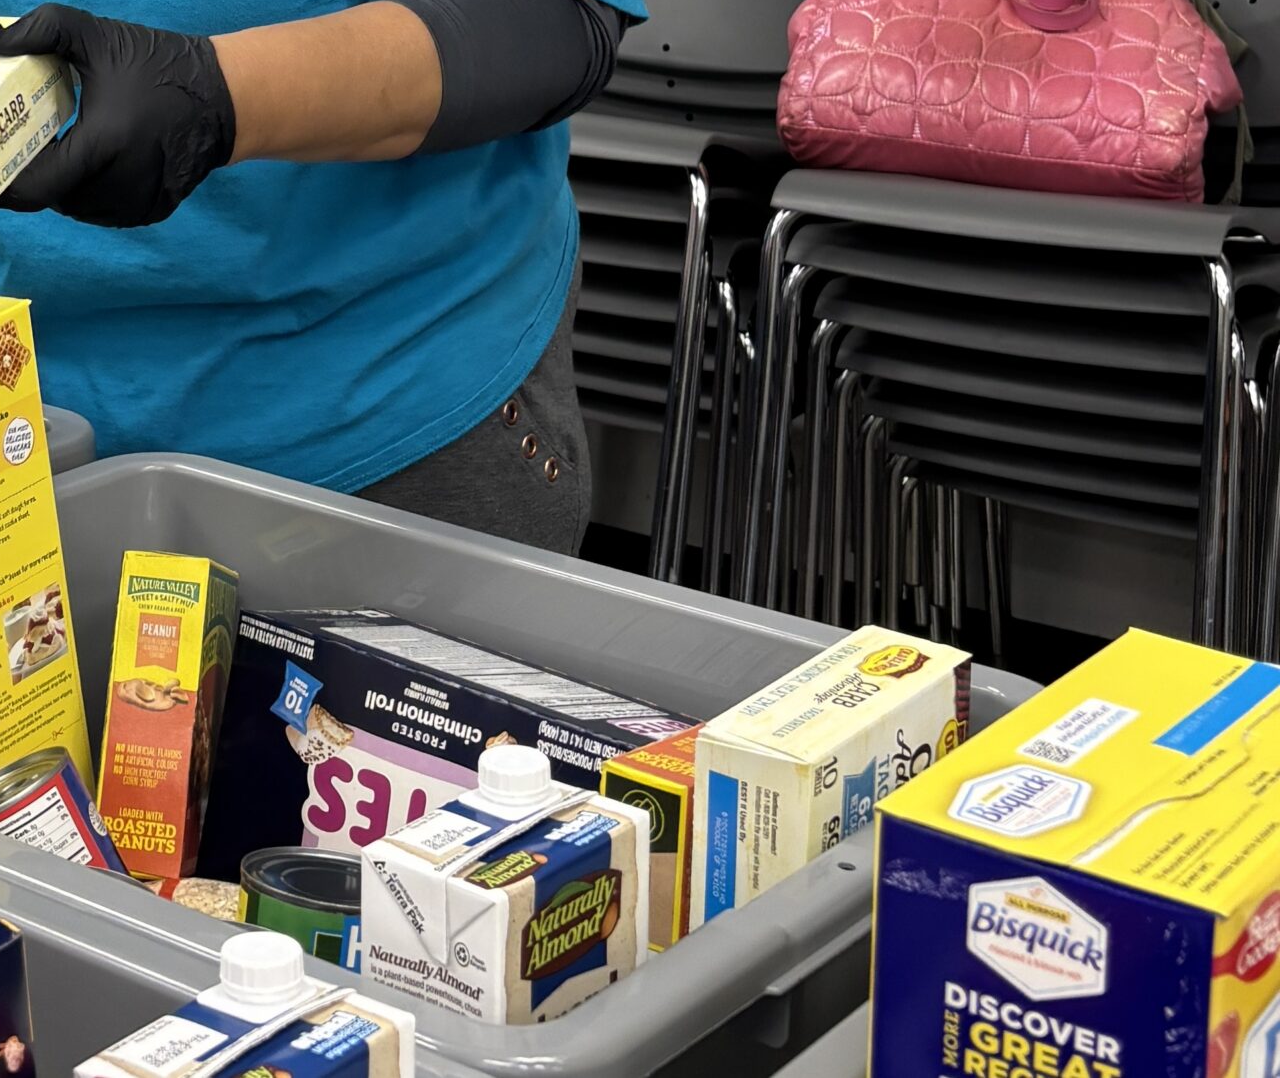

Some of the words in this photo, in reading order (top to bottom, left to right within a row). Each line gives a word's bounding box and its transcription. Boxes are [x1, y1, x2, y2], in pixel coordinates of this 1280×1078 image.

[132, 578, 165, 592] NATURE
[166, 582, 196, 598] VALLEY
[132, 594, 153, 602] SWEET
[160, 595, 179, 604] SALTY
[181, 600, 194, 609] NUT
[142, 623, 176, 638] PEANUT
[365, 690, 393, 711] roll
[814, 673, 863, 703] Advantage
[832, 682, 880, 708] CARB
[285, 690, 303, 715] 10
[397, 701, 483, 743] cinnamon
[392, 723, 447, 750] FROSTED
[126, 755, 154, 768] ARTIFICIAL
[156, 760, 178, 770] COLORS
[127, 744, 155, 756] ARTIFICIAL
[158, 748, 182, 759] FLAVORS
[139, 768, 167, 780] FRUCTOSE
[823, 756, 837, 789] 10
[970, 769, 1055, 822] Bisquick
[104, 817, 176, 838] ROASTED
[120, 807, 143, 818] LOADED
[146, 811, 163, 821] WITH
[112, 832, 176, 854] EANUTS
[470, 851, 533, 882] Naturally
[485, 859, 536, 888] Almond
[386, 875, 411, 906] Tetra
[407, 909, 425, 934] Pak
[528, 875, 616, 946] Naturally
[527, 904, 604, 975] Almond
[970, 902, 1104, 973] Bisquick
[369, 945, 434, 979] Naturally
[433, 966, 484, 1001] Almond
[384, 969, 424, 989] plant-based
[945, 981, 1120, 1059] DISCOVER
[943, 1010, 959, 1067] MORE
[970, 1020, 1120, 1078] GREAT
